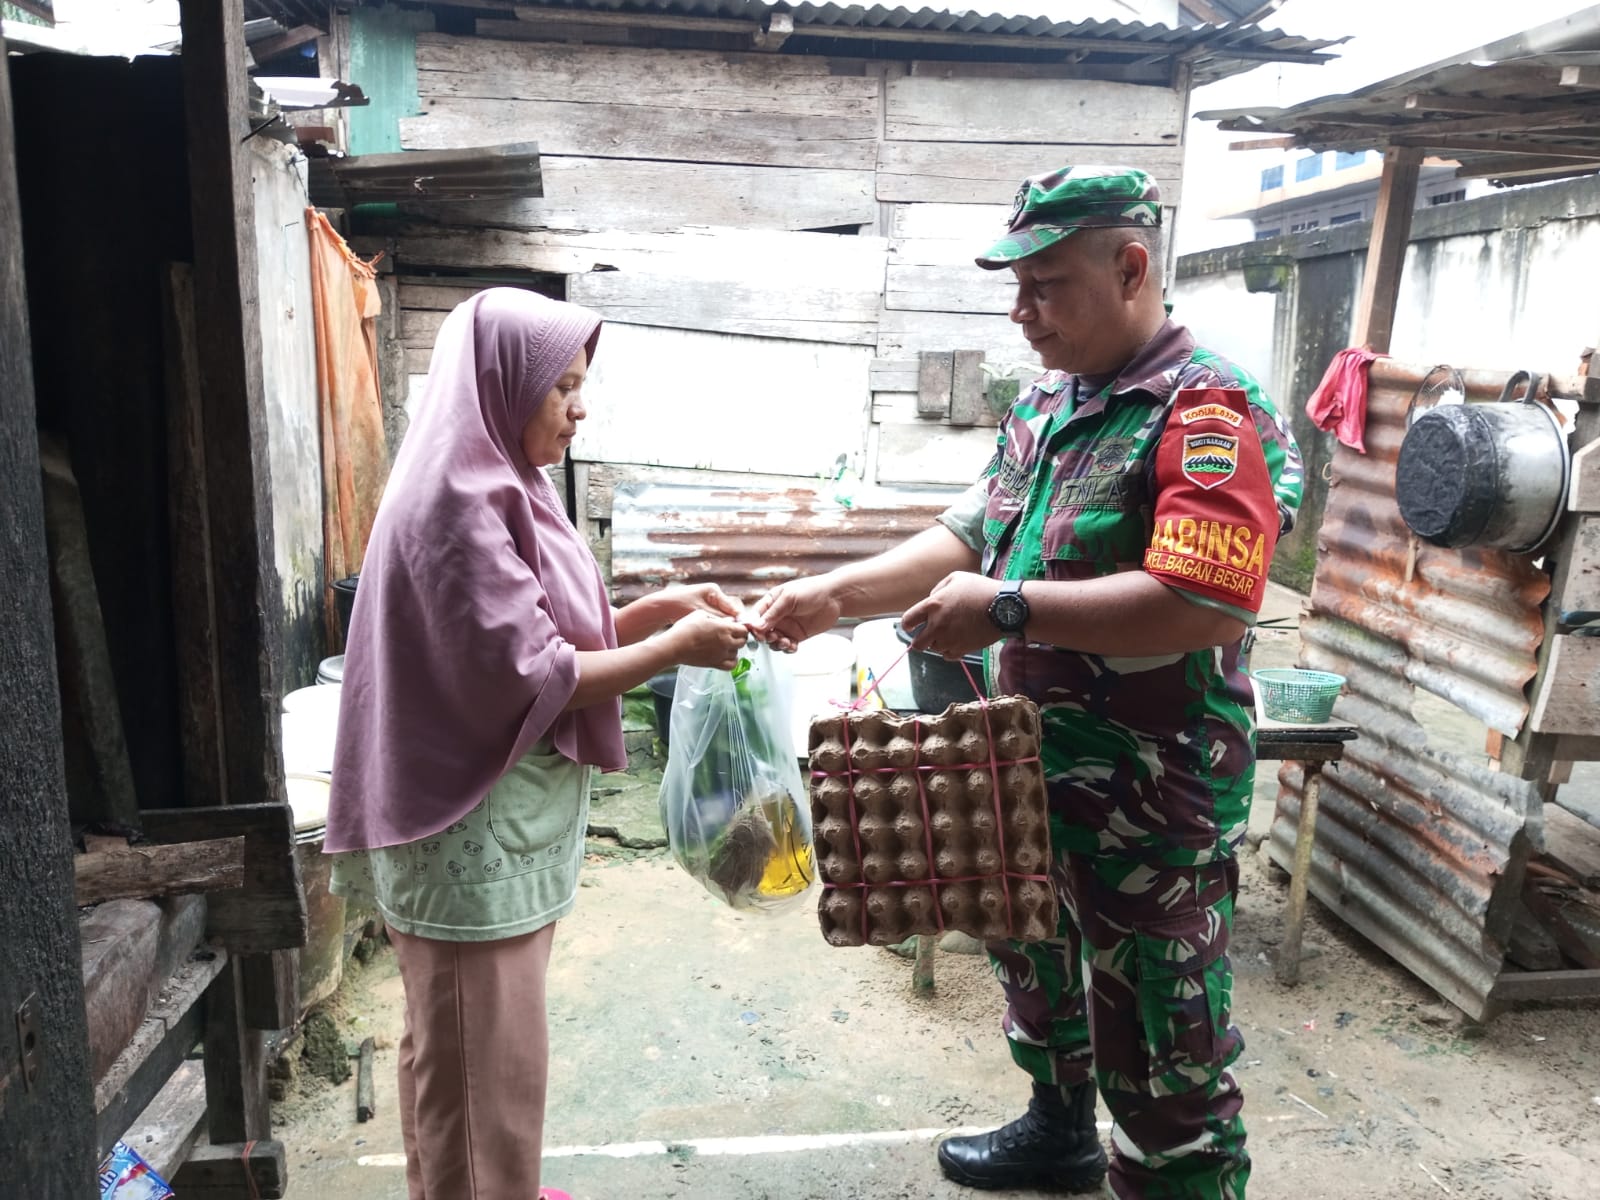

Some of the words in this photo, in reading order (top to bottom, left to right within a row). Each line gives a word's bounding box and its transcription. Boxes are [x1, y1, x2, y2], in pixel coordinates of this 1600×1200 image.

[1065, 479, 1097, 503] TNI
[1165, 555, 1213, 582] BAGAN
[1213, 568, 1254, 595] BESAR
